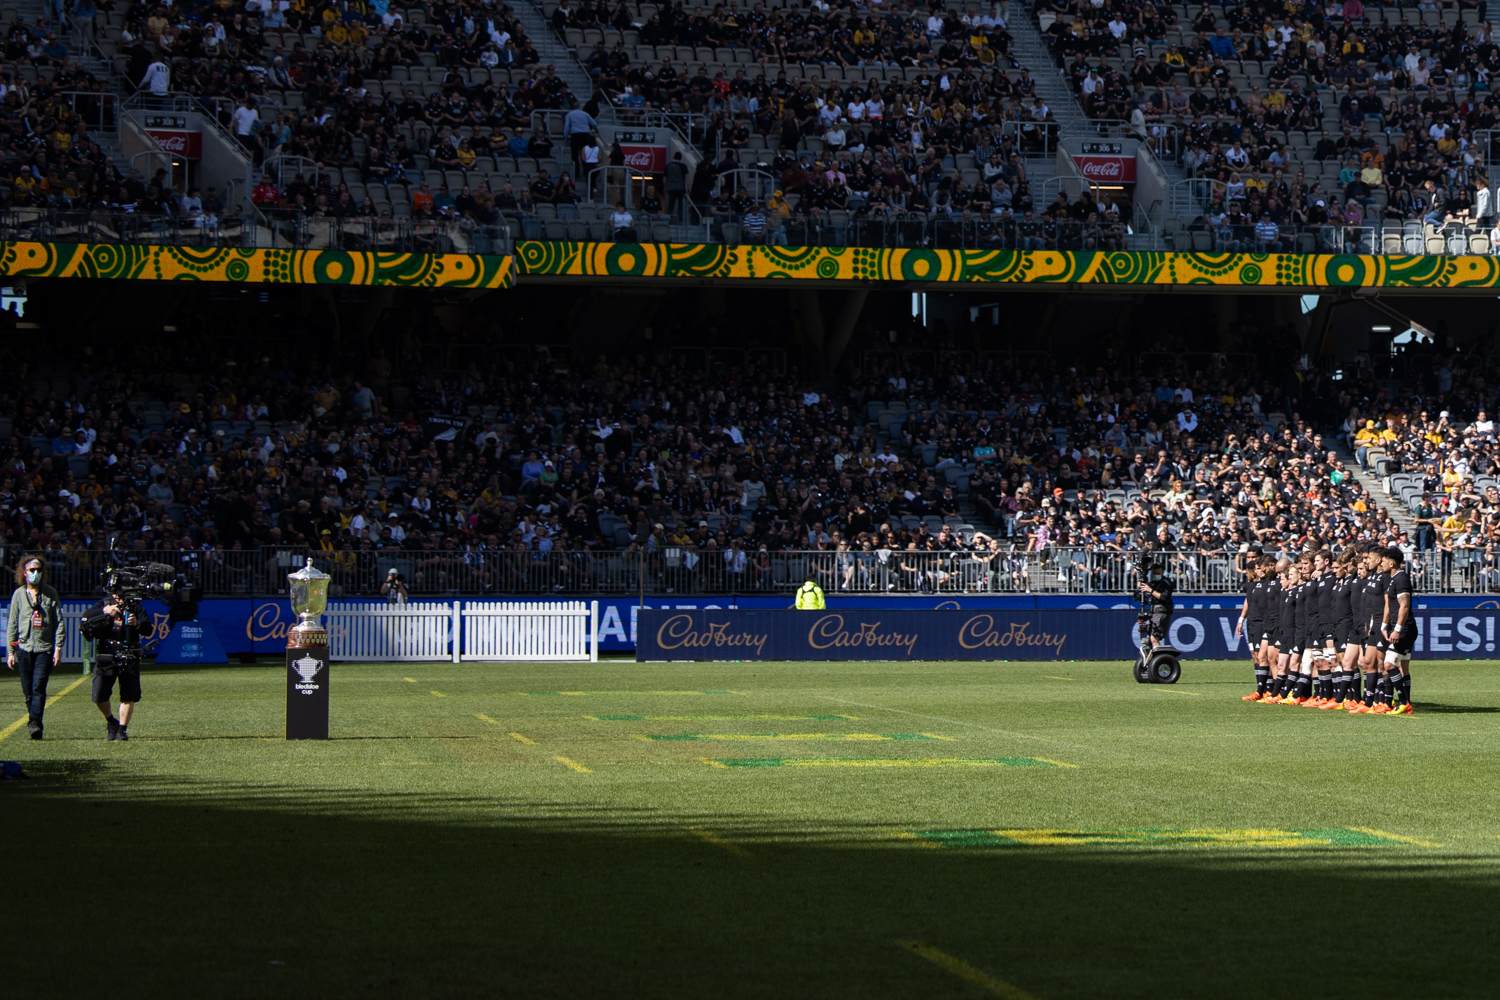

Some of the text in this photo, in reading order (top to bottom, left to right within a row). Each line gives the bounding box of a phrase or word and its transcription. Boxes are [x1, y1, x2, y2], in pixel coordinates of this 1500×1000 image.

[657, 614, 768, 656] Cadbury
[808, 614, 918, 656] Cadbury
[958, 614, 1067, 656] Cadbury
